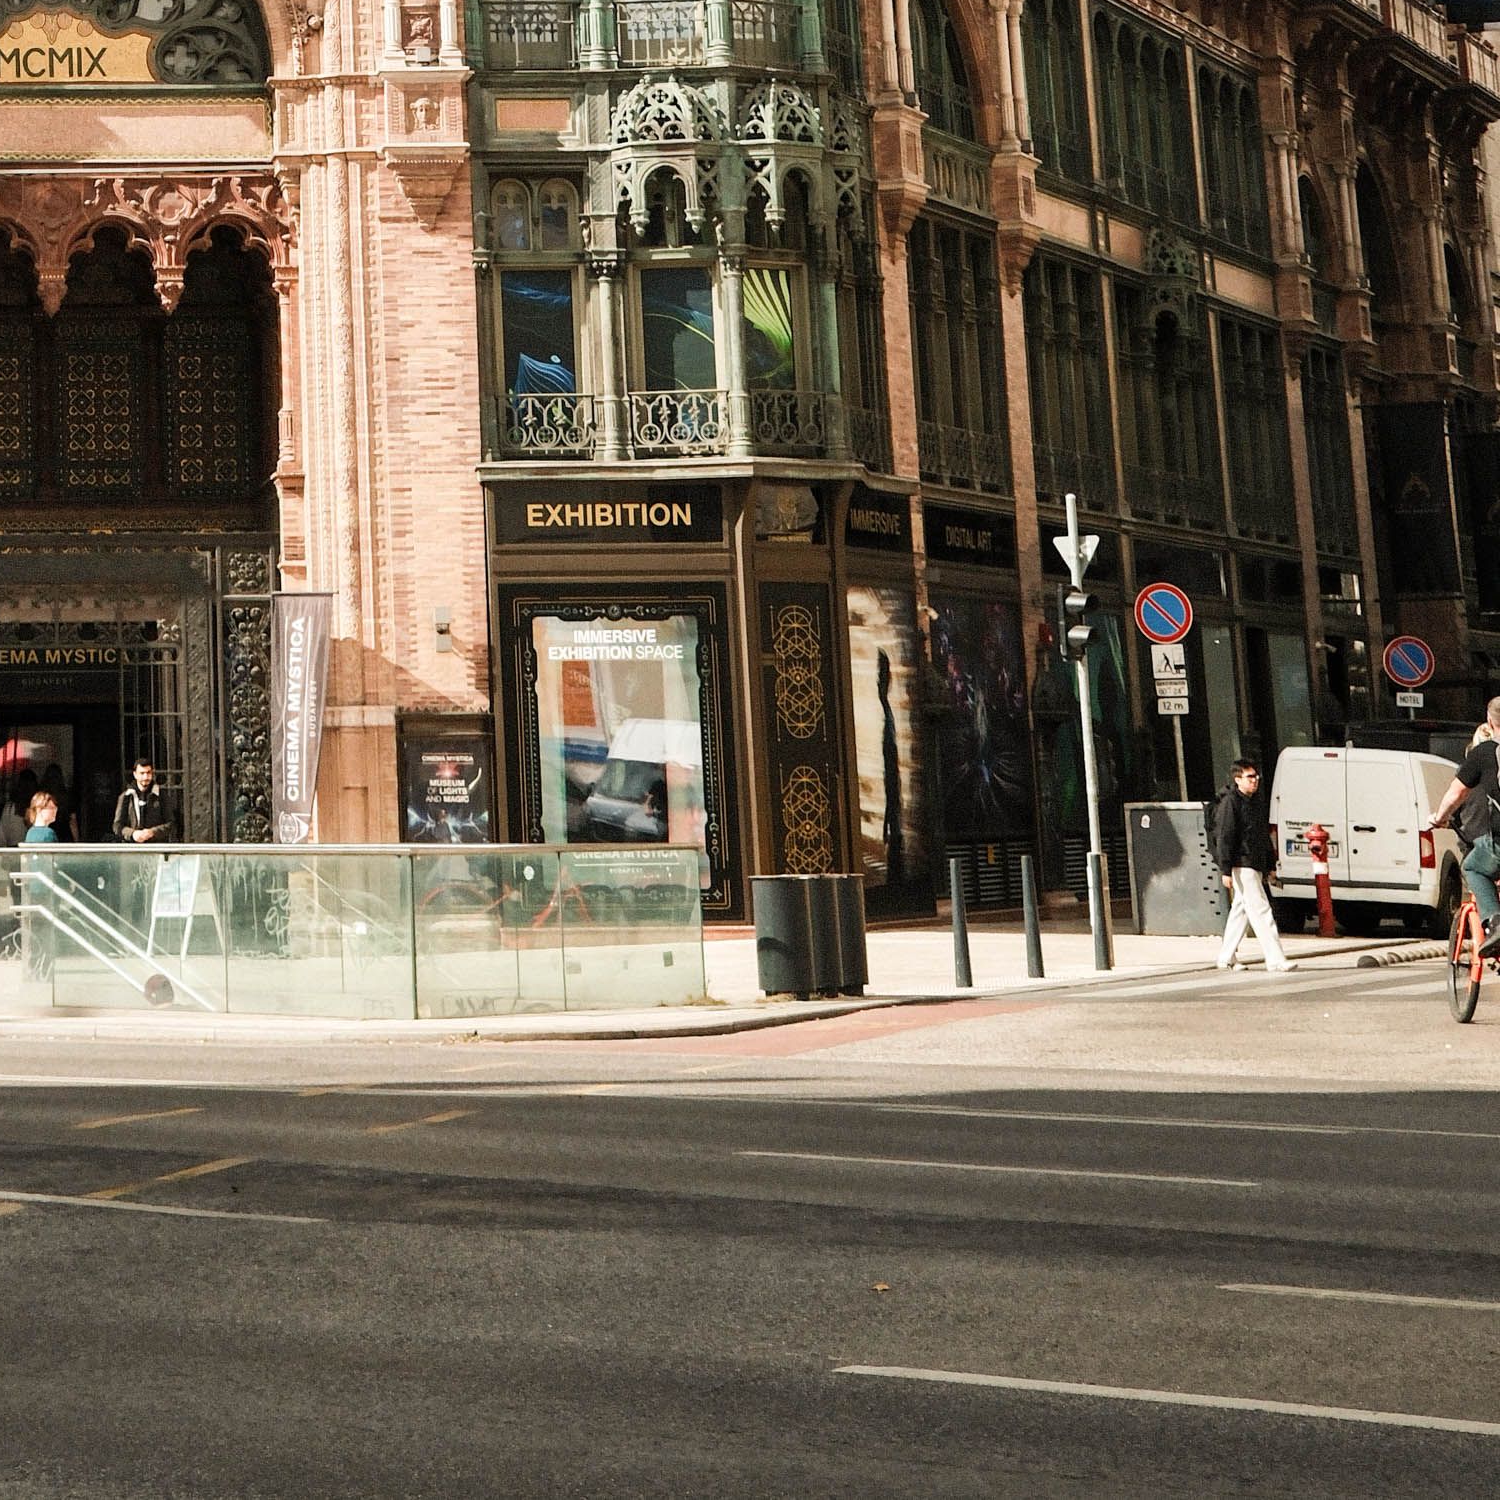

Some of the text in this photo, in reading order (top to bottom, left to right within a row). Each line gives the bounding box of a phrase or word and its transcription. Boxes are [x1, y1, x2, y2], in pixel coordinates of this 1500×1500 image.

[526, 502, 692, 527] EXHIBITION
[850, 508, 901, 535] IMMERSIVE
[946, 526, 992, 550] DIGITAL ART
[573, 629, 657, 643] IMMERSIVE
[548, 645, 684, 660] EXHIBITION SPACE
[286, 616, 306, 802] CINEMA MYSTICA
[309, 679, 318, 738] BUDAPEST
[1162, 701, 1172, 710] 12
